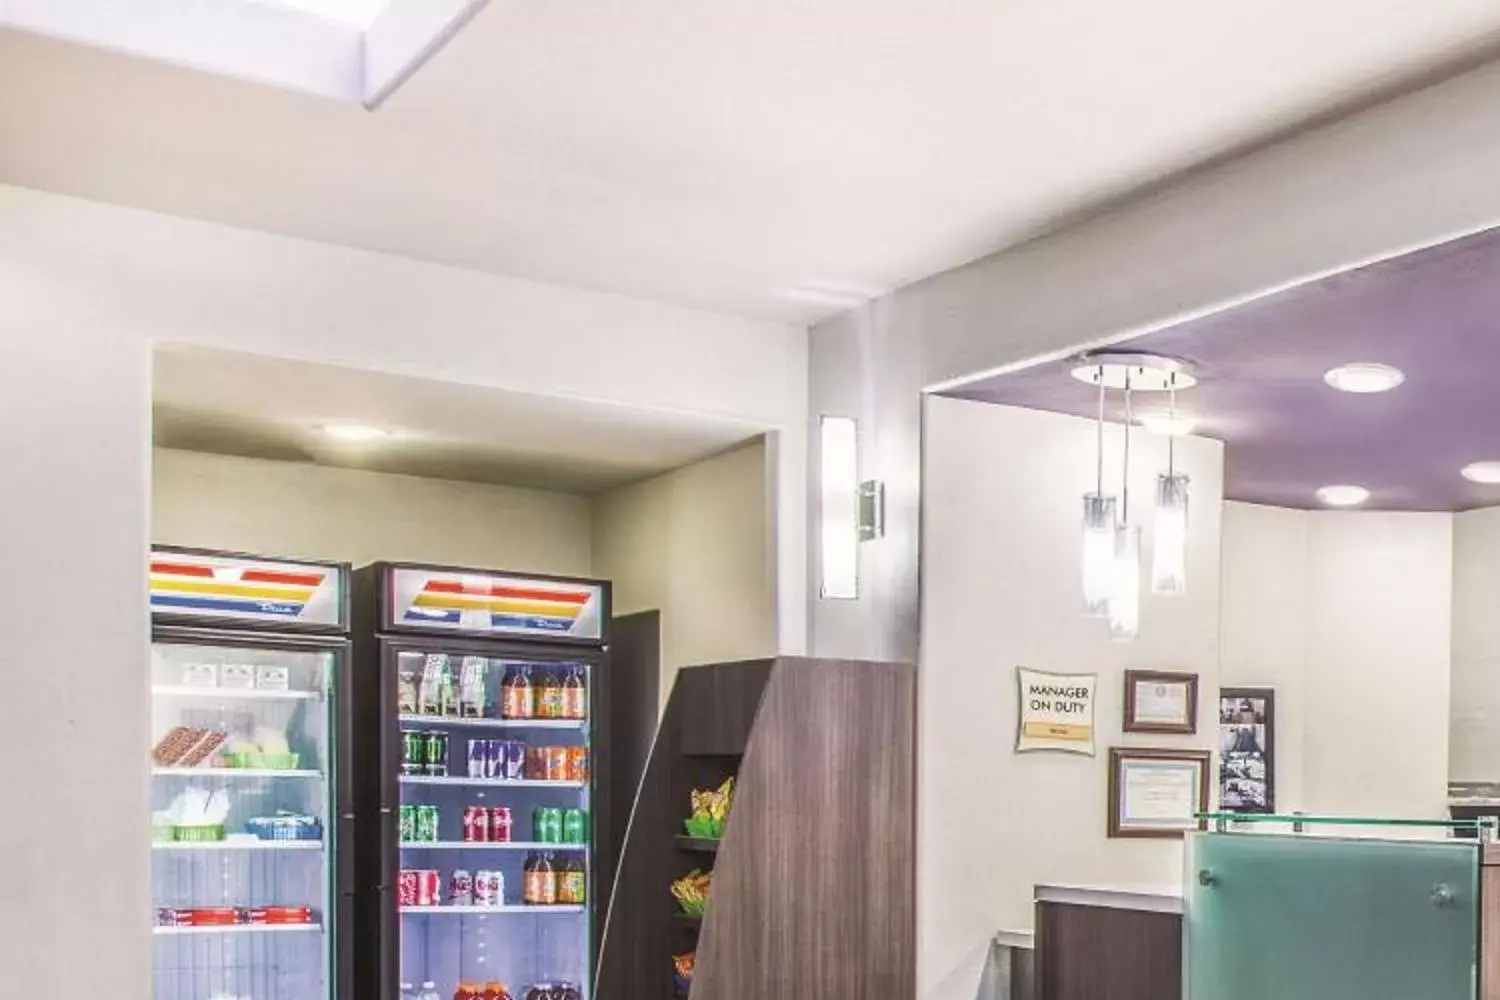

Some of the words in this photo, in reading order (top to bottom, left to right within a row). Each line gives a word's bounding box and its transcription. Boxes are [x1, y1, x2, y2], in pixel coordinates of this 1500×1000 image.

[1029, 685, 1089, 699] MANAGER
[1030, 699, 1051, 711] ON
[1055, 701, 1086, 714] DUTY
